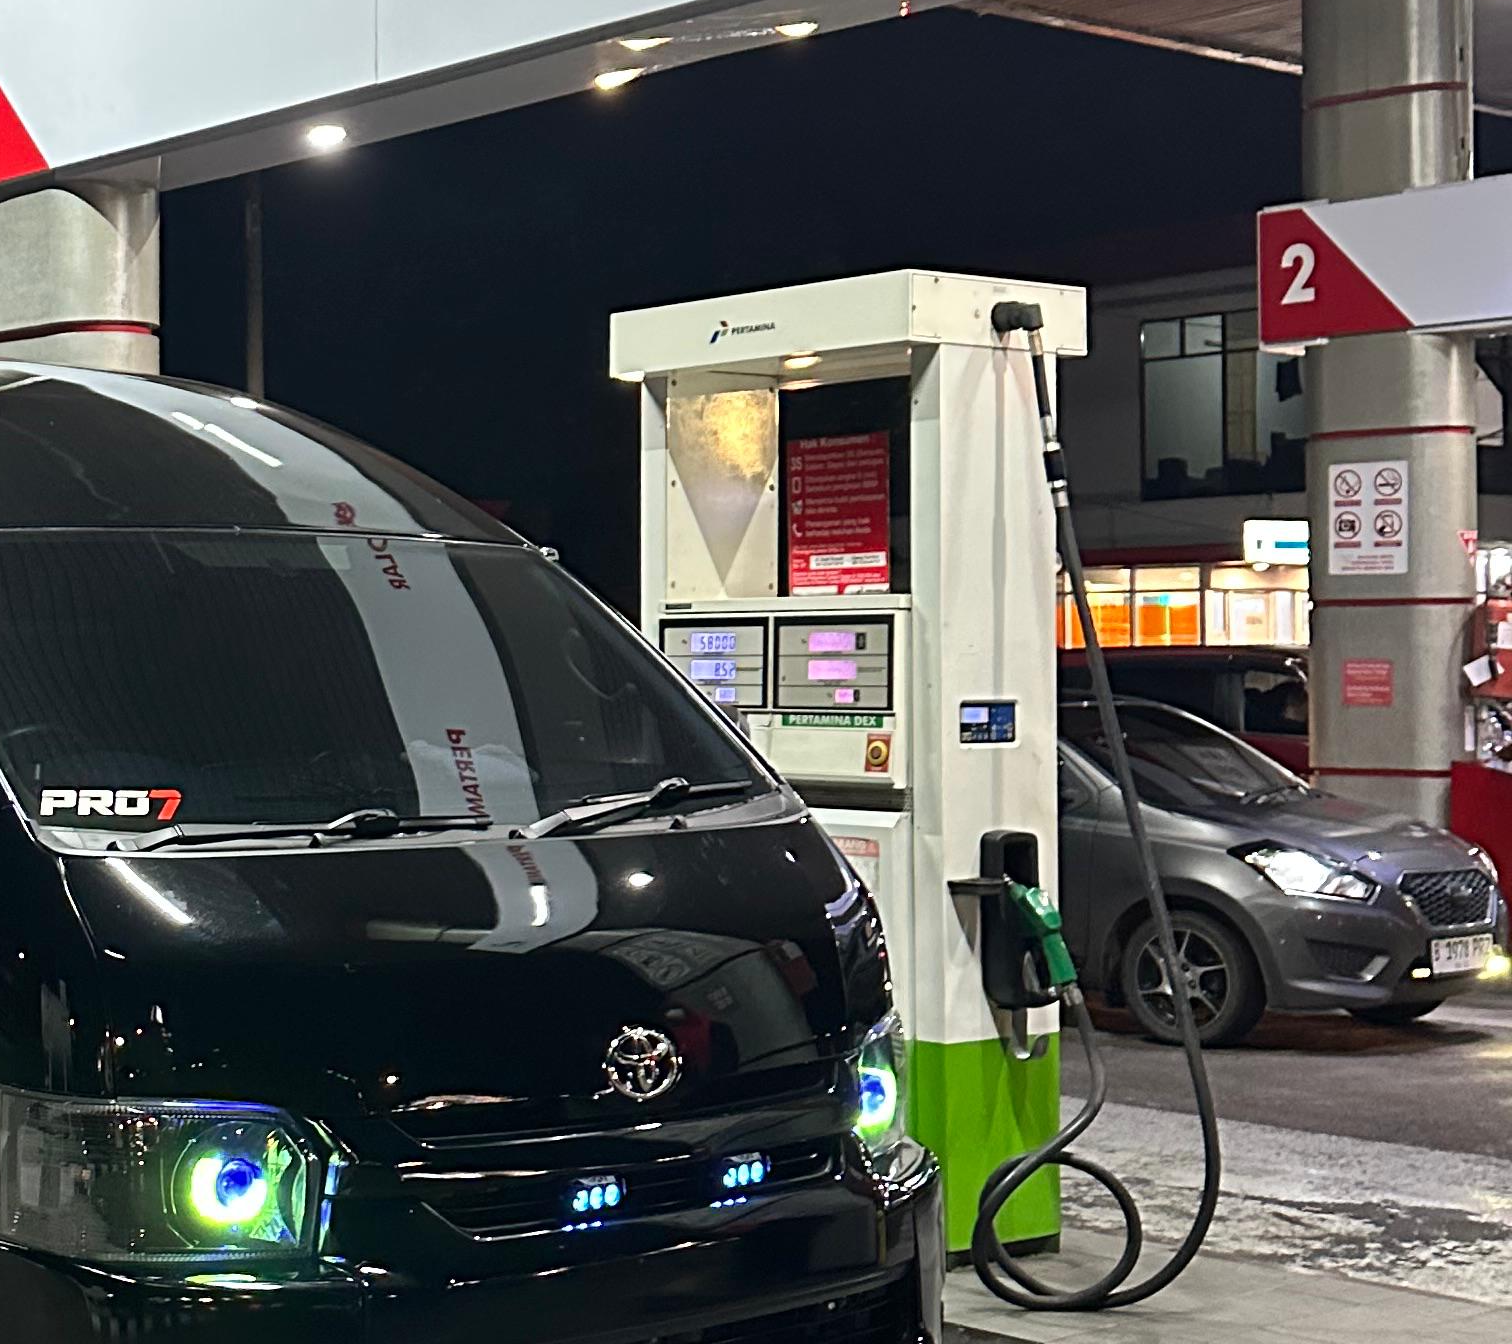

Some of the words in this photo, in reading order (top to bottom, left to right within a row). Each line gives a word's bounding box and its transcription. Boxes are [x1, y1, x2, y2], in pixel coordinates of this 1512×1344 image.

[1280, 242, 1317, 305] 2
[731, 322, 776, 336] PERTAMINA
[788, 714, 851, 726] PERTAMINA
[853, 715, 877, 727] DEX
[39, 788, 182, 821] PRO7
